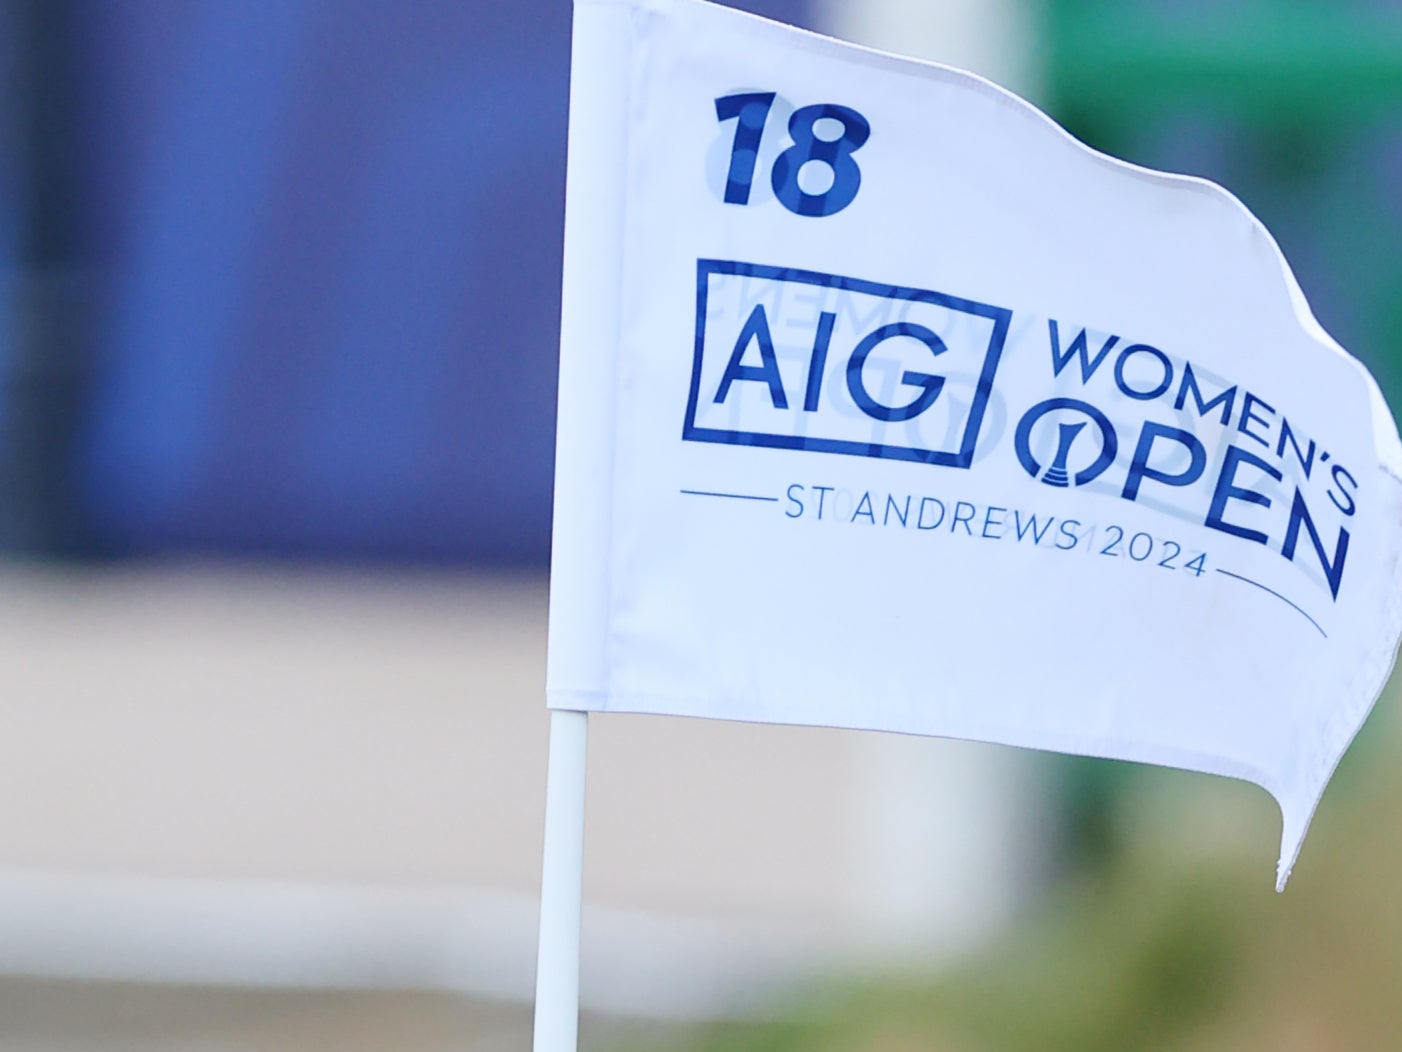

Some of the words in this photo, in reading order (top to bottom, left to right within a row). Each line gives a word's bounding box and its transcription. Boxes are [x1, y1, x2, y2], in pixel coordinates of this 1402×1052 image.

[714, 90, 871, 218] 18
[712, 303, 949, 422] AIG
[1047, 318, 1359, 517] WOMEN'S
[784, 483, 835, 520] ST
[850, 490, 1082, 550] ANDREWS
[1099, 525, 1208, 577] 2024
[1014, 397, 1351, 603] OPEN
